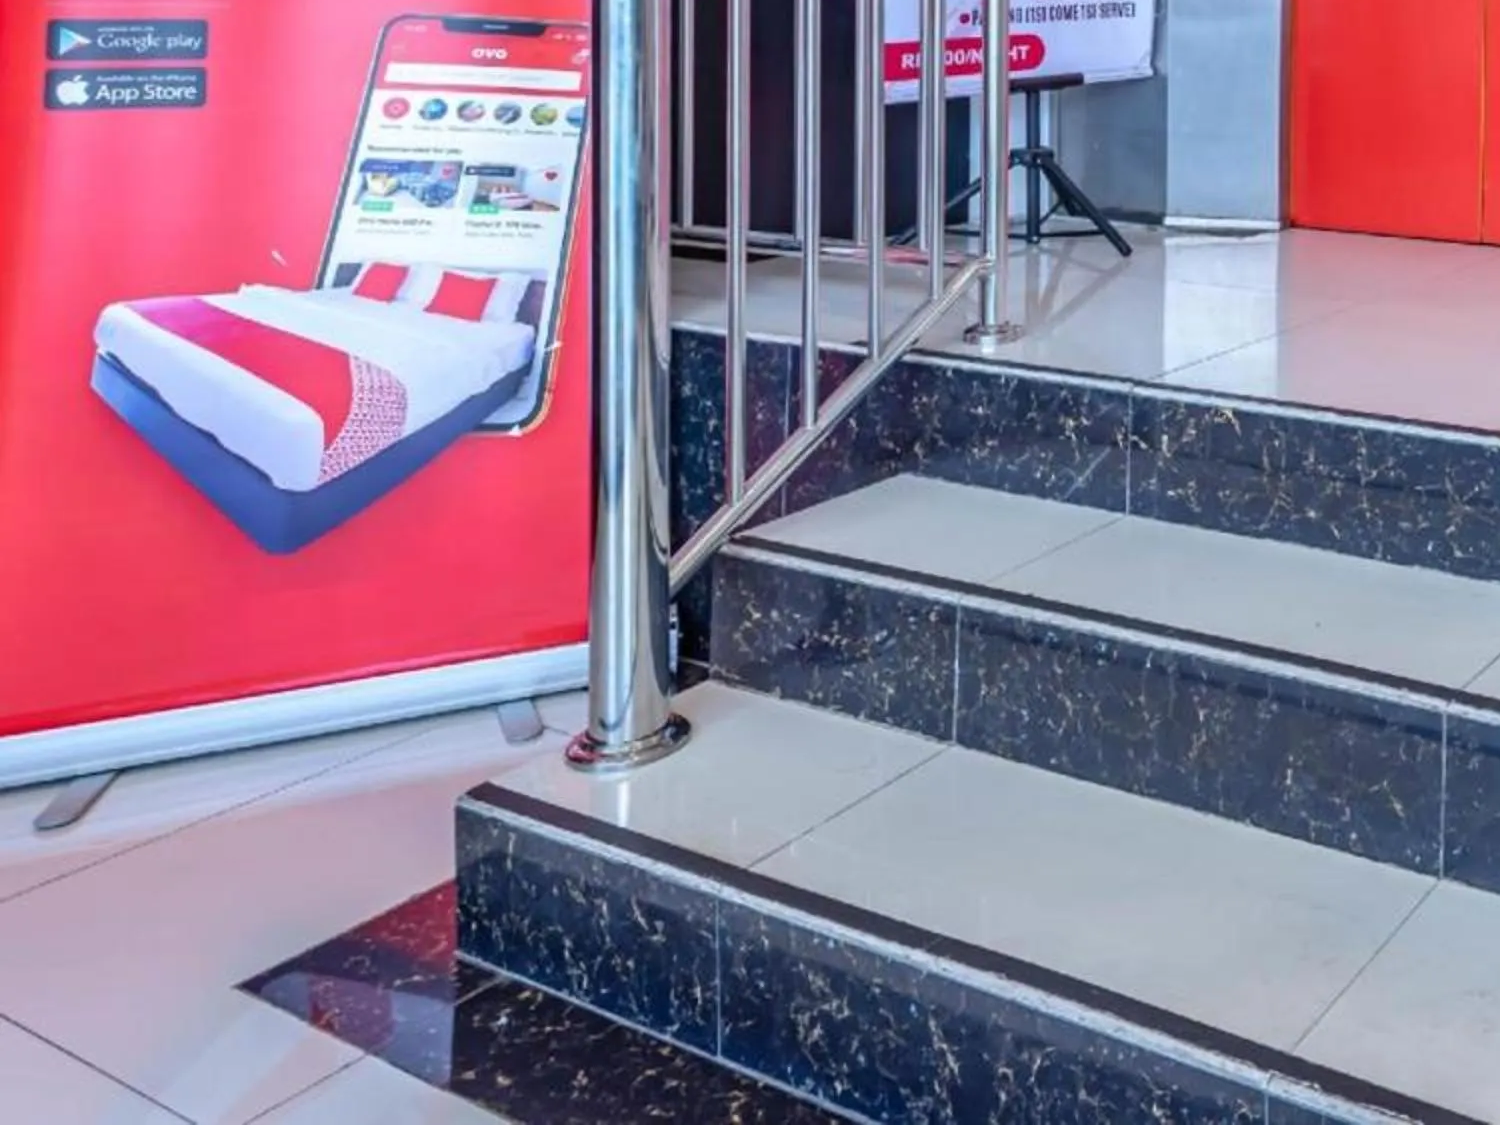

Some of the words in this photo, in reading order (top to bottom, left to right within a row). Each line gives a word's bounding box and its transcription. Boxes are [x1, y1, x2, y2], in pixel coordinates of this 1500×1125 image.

[1049, 3, 1079, 22] COME
[97, 33, 162, 54] Google
[165, 33, 202, 50] play
[470, 47, 508, 60] OYO
[95, 84, 140, 105] App
[143, 83, 197, 100] Store
